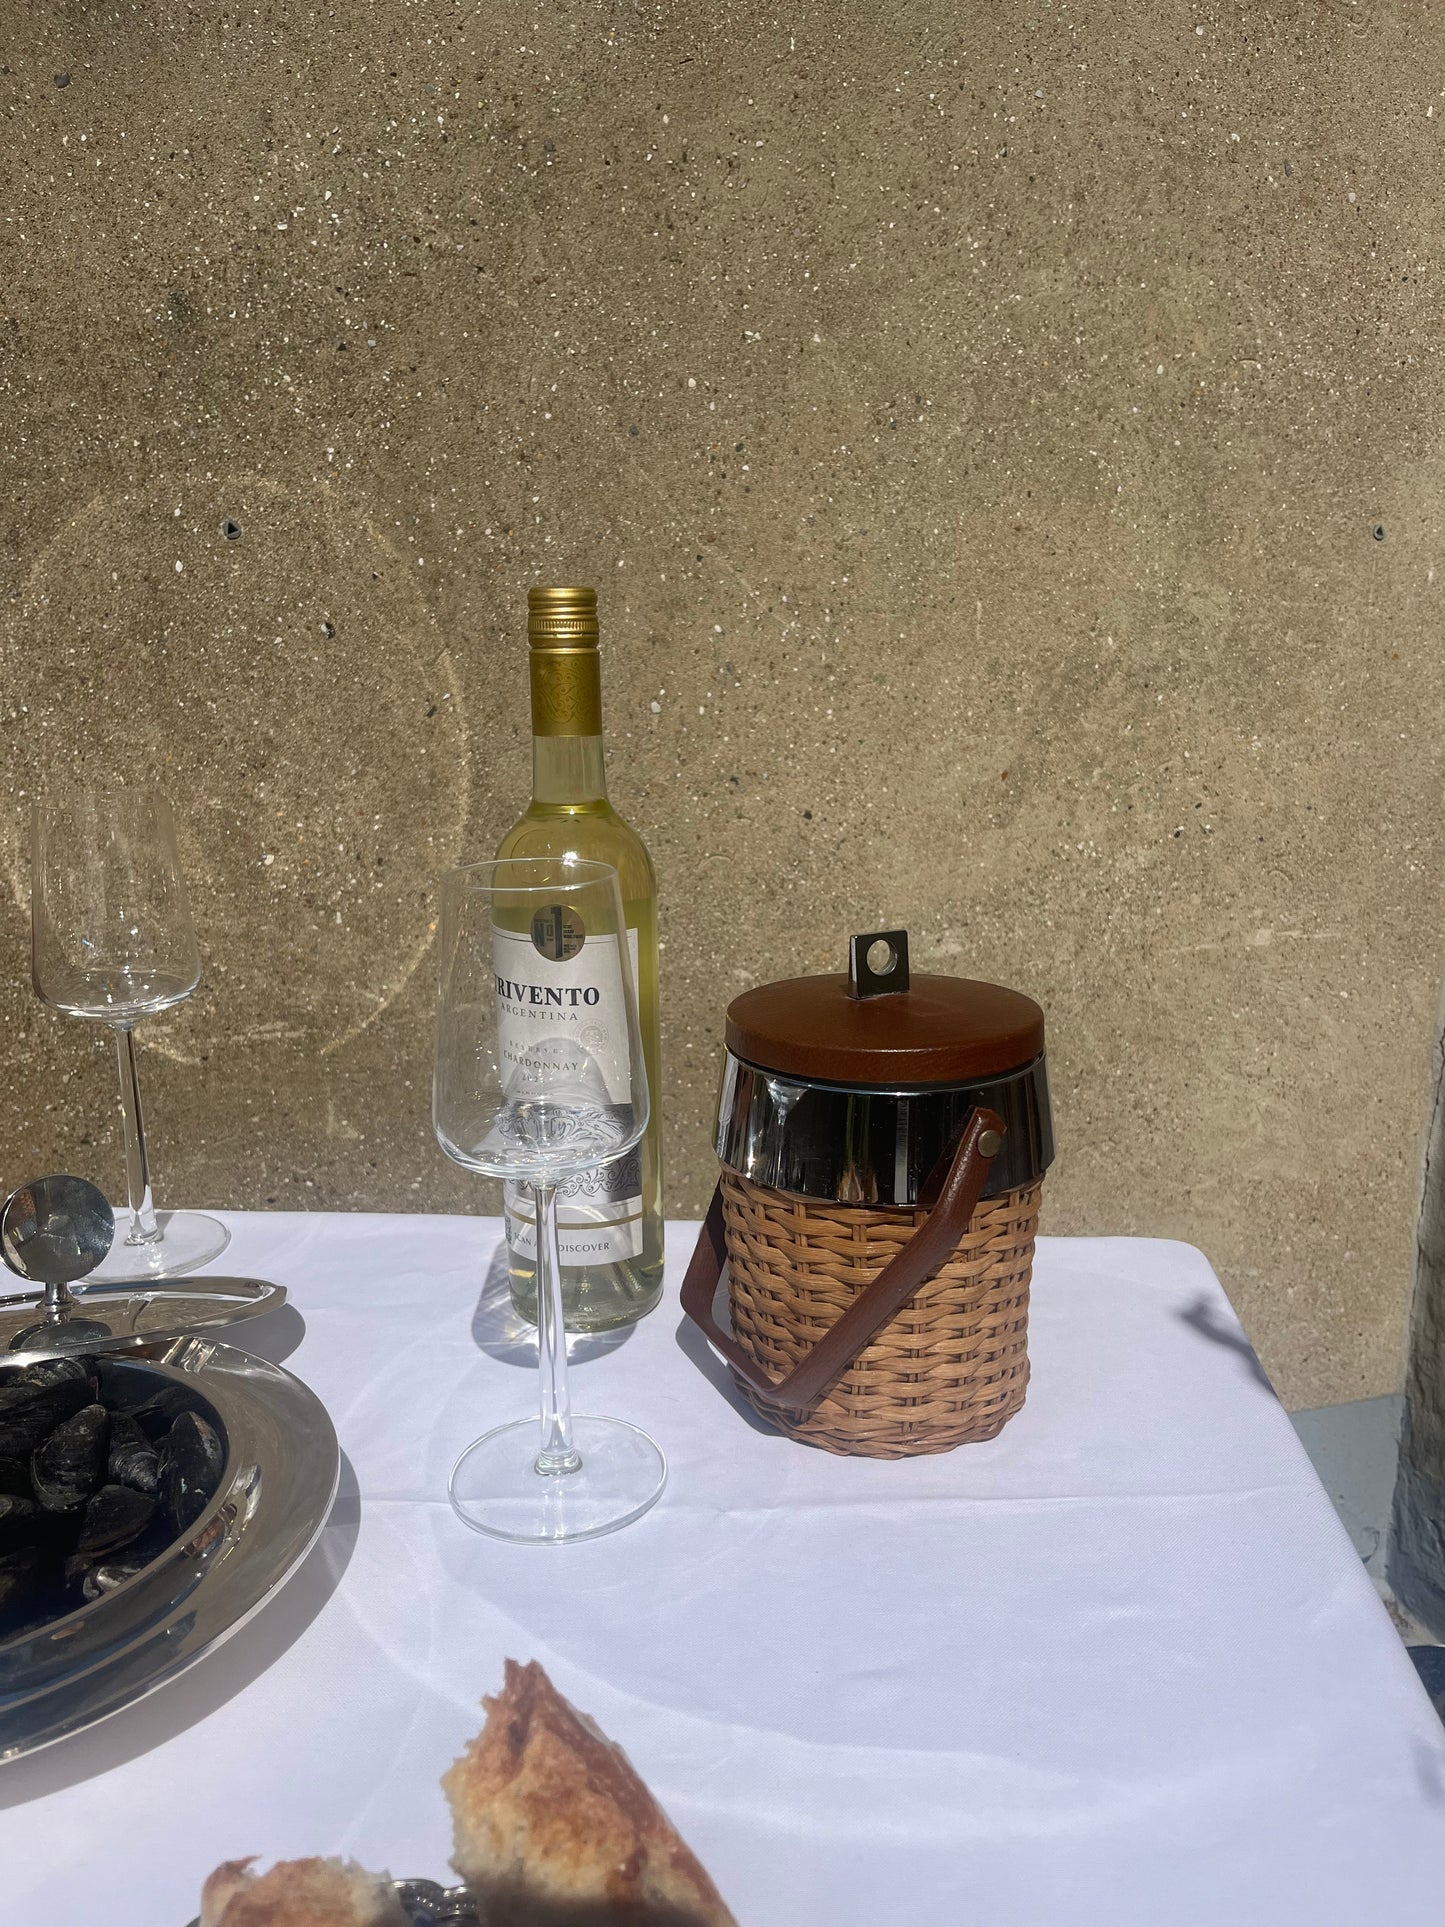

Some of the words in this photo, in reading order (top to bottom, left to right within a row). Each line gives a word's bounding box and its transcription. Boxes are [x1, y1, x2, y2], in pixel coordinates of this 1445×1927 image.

[500, 1002, 579, 1021] ARGENTINA
[503, 1050, 579, 1071] CHARDONNAY
[558, 1242, 610, 1253] DISCOVER
